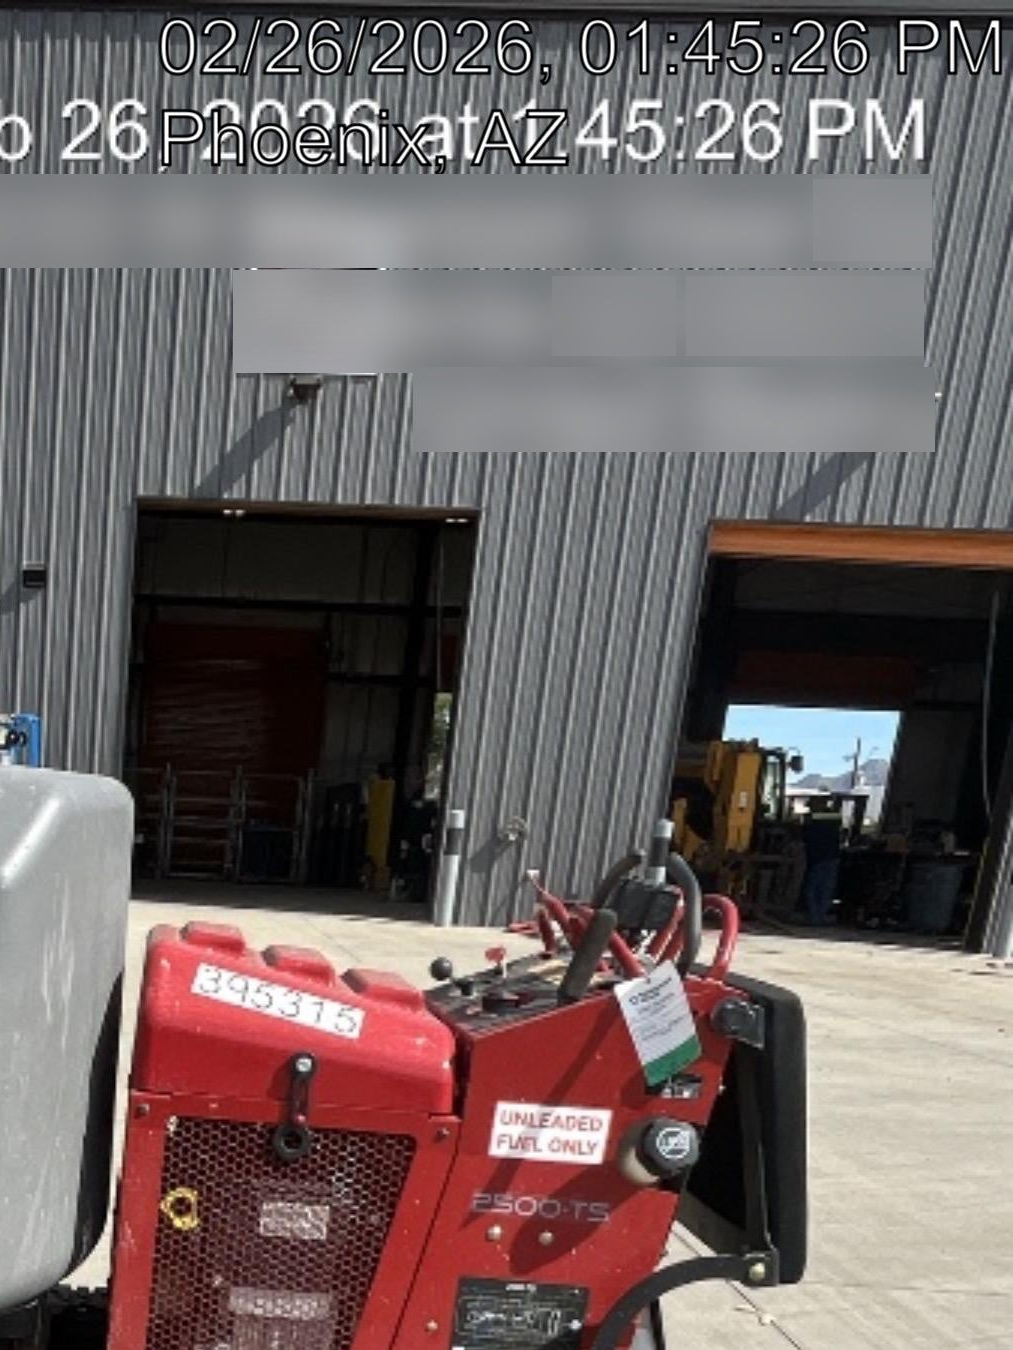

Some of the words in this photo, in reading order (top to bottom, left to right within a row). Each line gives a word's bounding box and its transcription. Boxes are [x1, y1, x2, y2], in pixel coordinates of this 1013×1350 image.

[499, 1108, 604, 1133] UNLEADED
[496, 1133, 544, 1153] FUEL
[547, 1136, 600, 1156] ONLY
